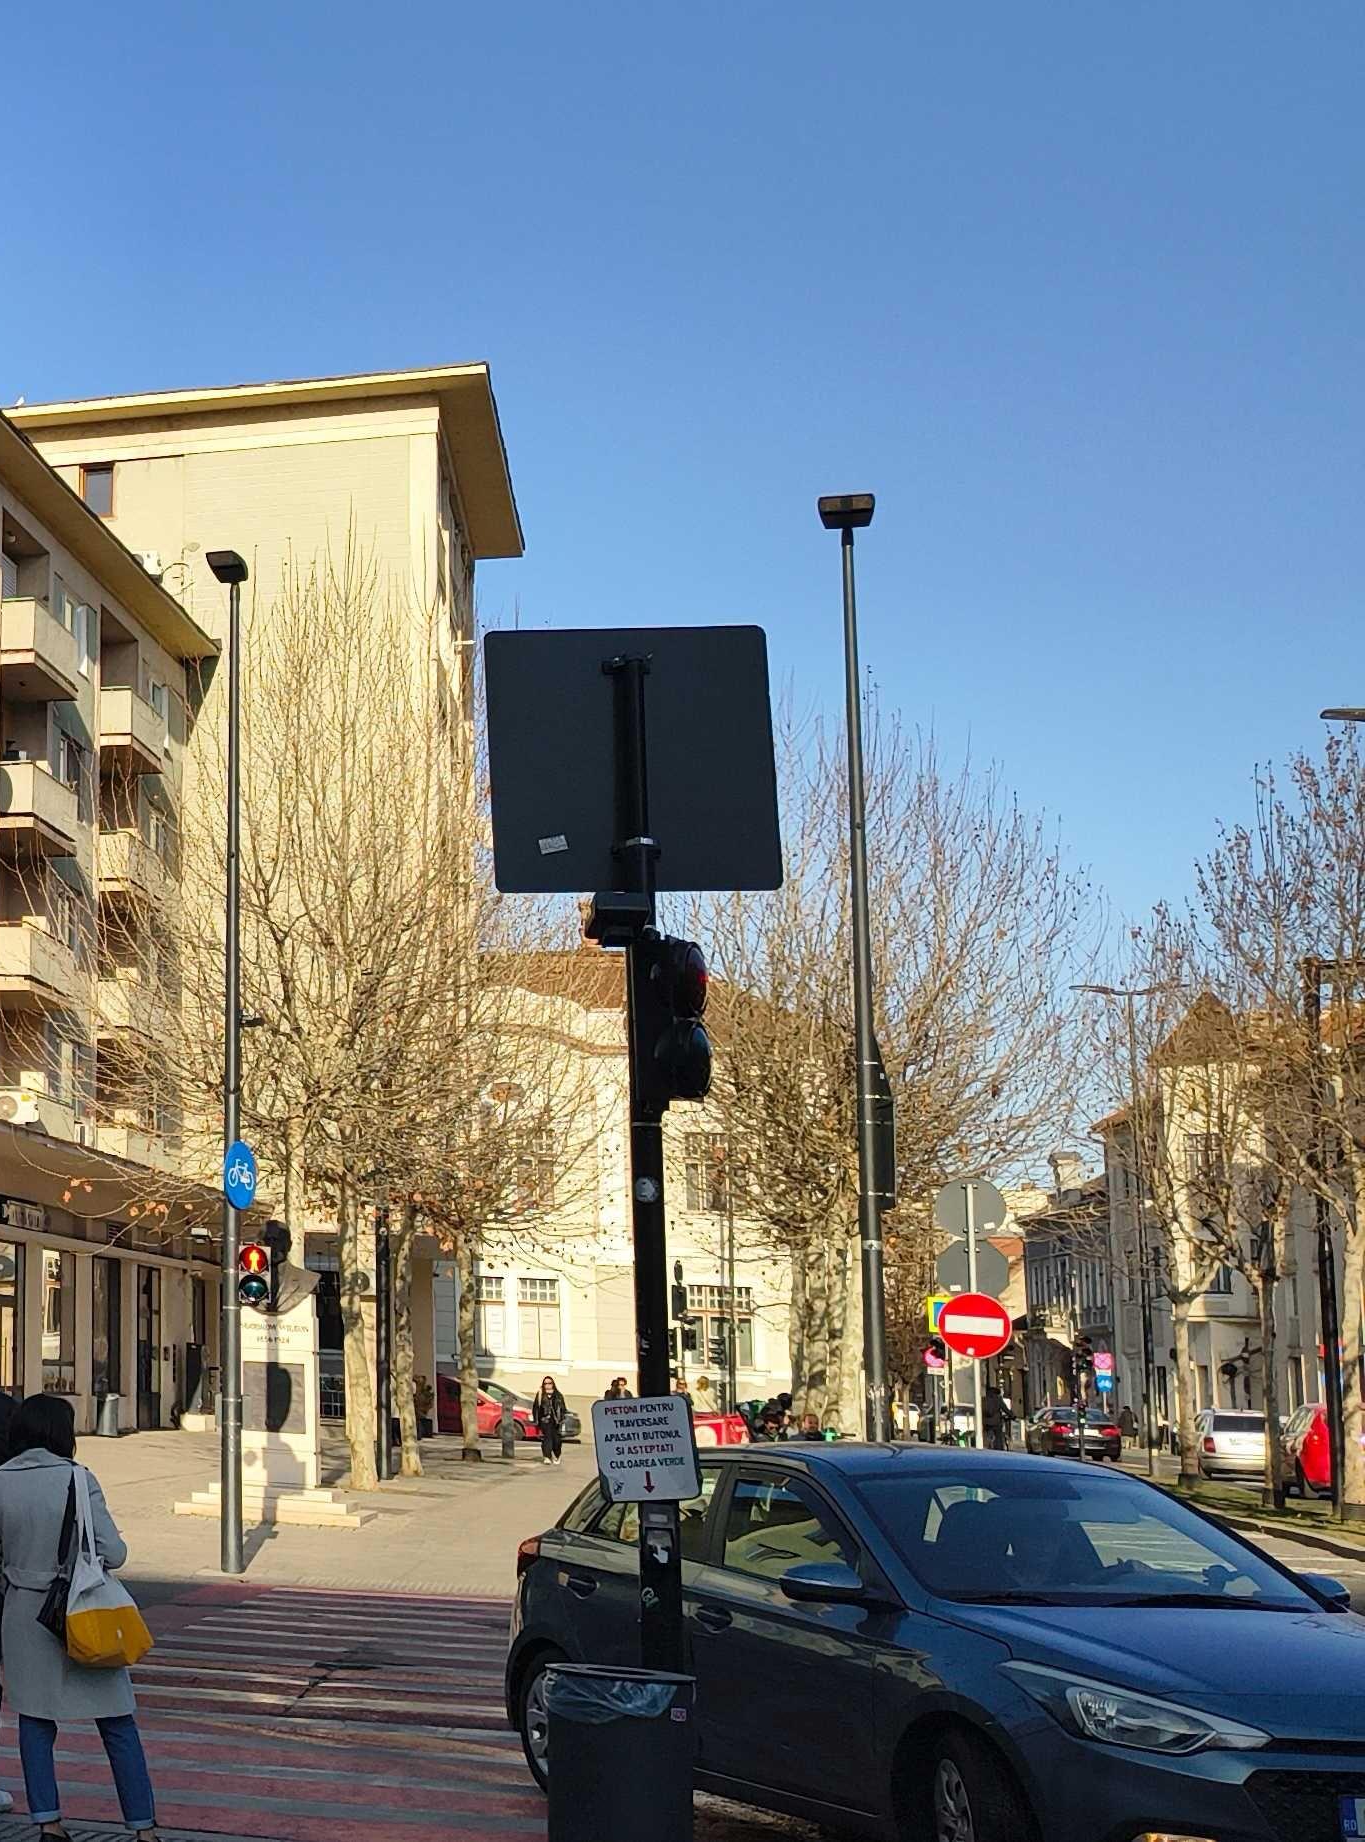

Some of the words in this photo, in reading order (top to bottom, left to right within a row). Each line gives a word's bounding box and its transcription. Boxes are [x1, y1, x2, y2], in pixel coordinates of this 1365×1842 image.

[604, 1404, 638, 1415] PIETONI
[640, 1402, 674, 1413] PENTRU
[613, 1416, 670, 1429] TRAVERSARE
[604, 1432, 640, 1442] APASATI
[642, 1430, 682, 1440] BUTONUL
[615, 1446, 624, 1455] SI
[627, 1444, 674, 1455] ASTEPTATI
[609, 1459, 657, 1469] CULOAREA
[657, 1457, 685, 1467] VERDE
